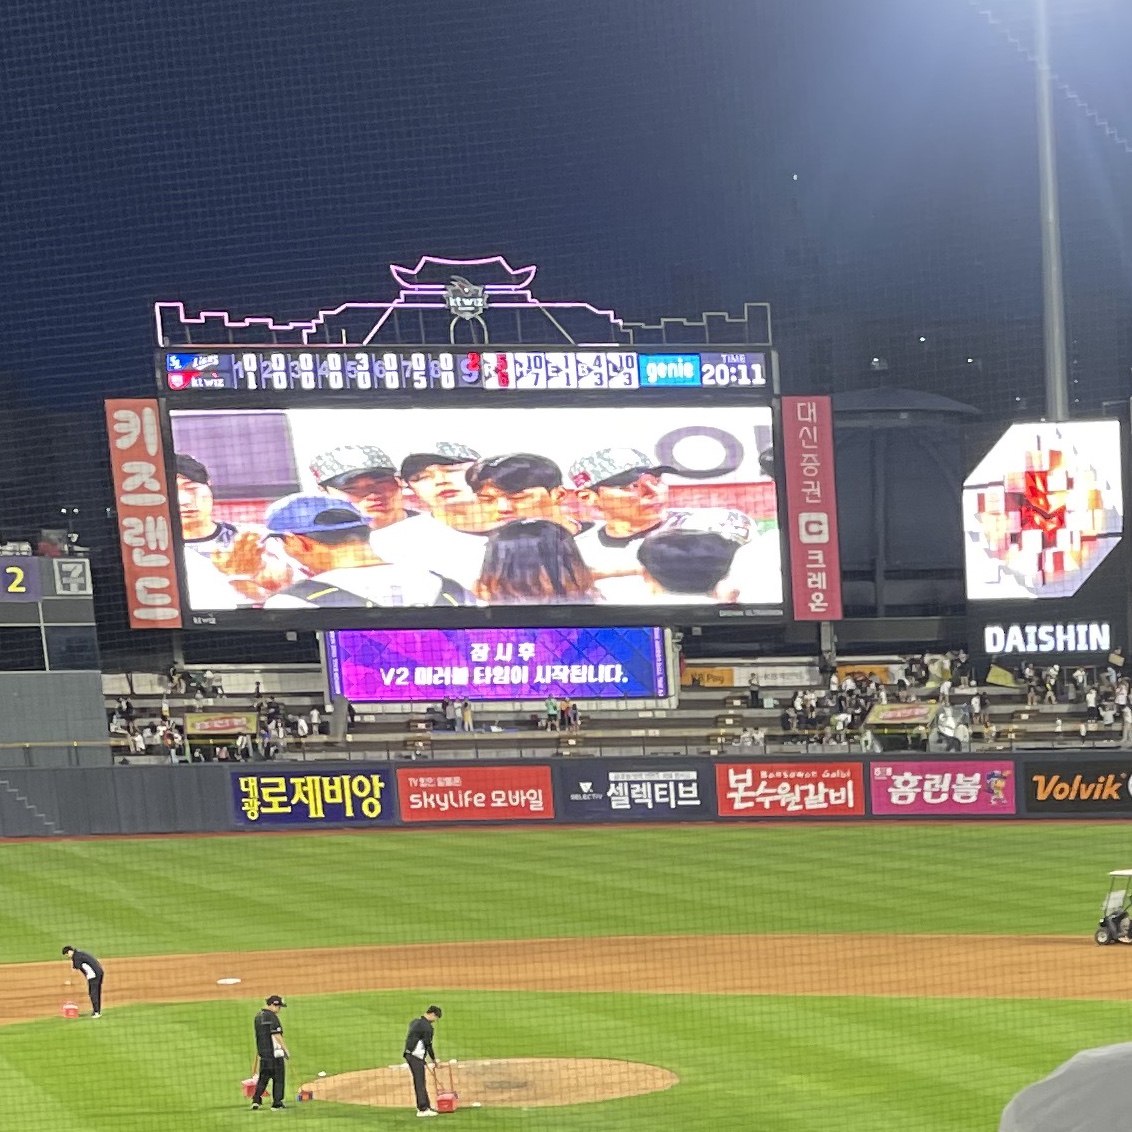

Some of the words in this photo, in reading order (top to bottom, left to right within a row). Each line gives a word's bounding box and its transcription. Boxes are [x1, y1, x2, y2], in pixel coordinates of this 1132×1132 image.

[646, 357, 694, 383] genie
[702, 363, 766, 386] 20:11
[797, 402, 821, 503] 대신증권
[113, 407, 180, 620] 키즈랜드
[6, 566, 26, 593] 2
[806, 550, 828, 613] 크레온
[985, 624, 1110, 652] DAISHIN
[381, 667, 409, 686] V2
[534, 664, 629, 685] 시작됩니다.
[260, 774, 385, 820] 로제비앙
[409, 790, 485, 811] skylife
[491, 789, 544, 811] 모바일
[607, 781, 701, 809] 셀렉티브
[726, 768, 855, 811] 본수원갈비
[887, 771, 983, 805] 홈런볼
[1032, 774, 1122, 801] Volvik
